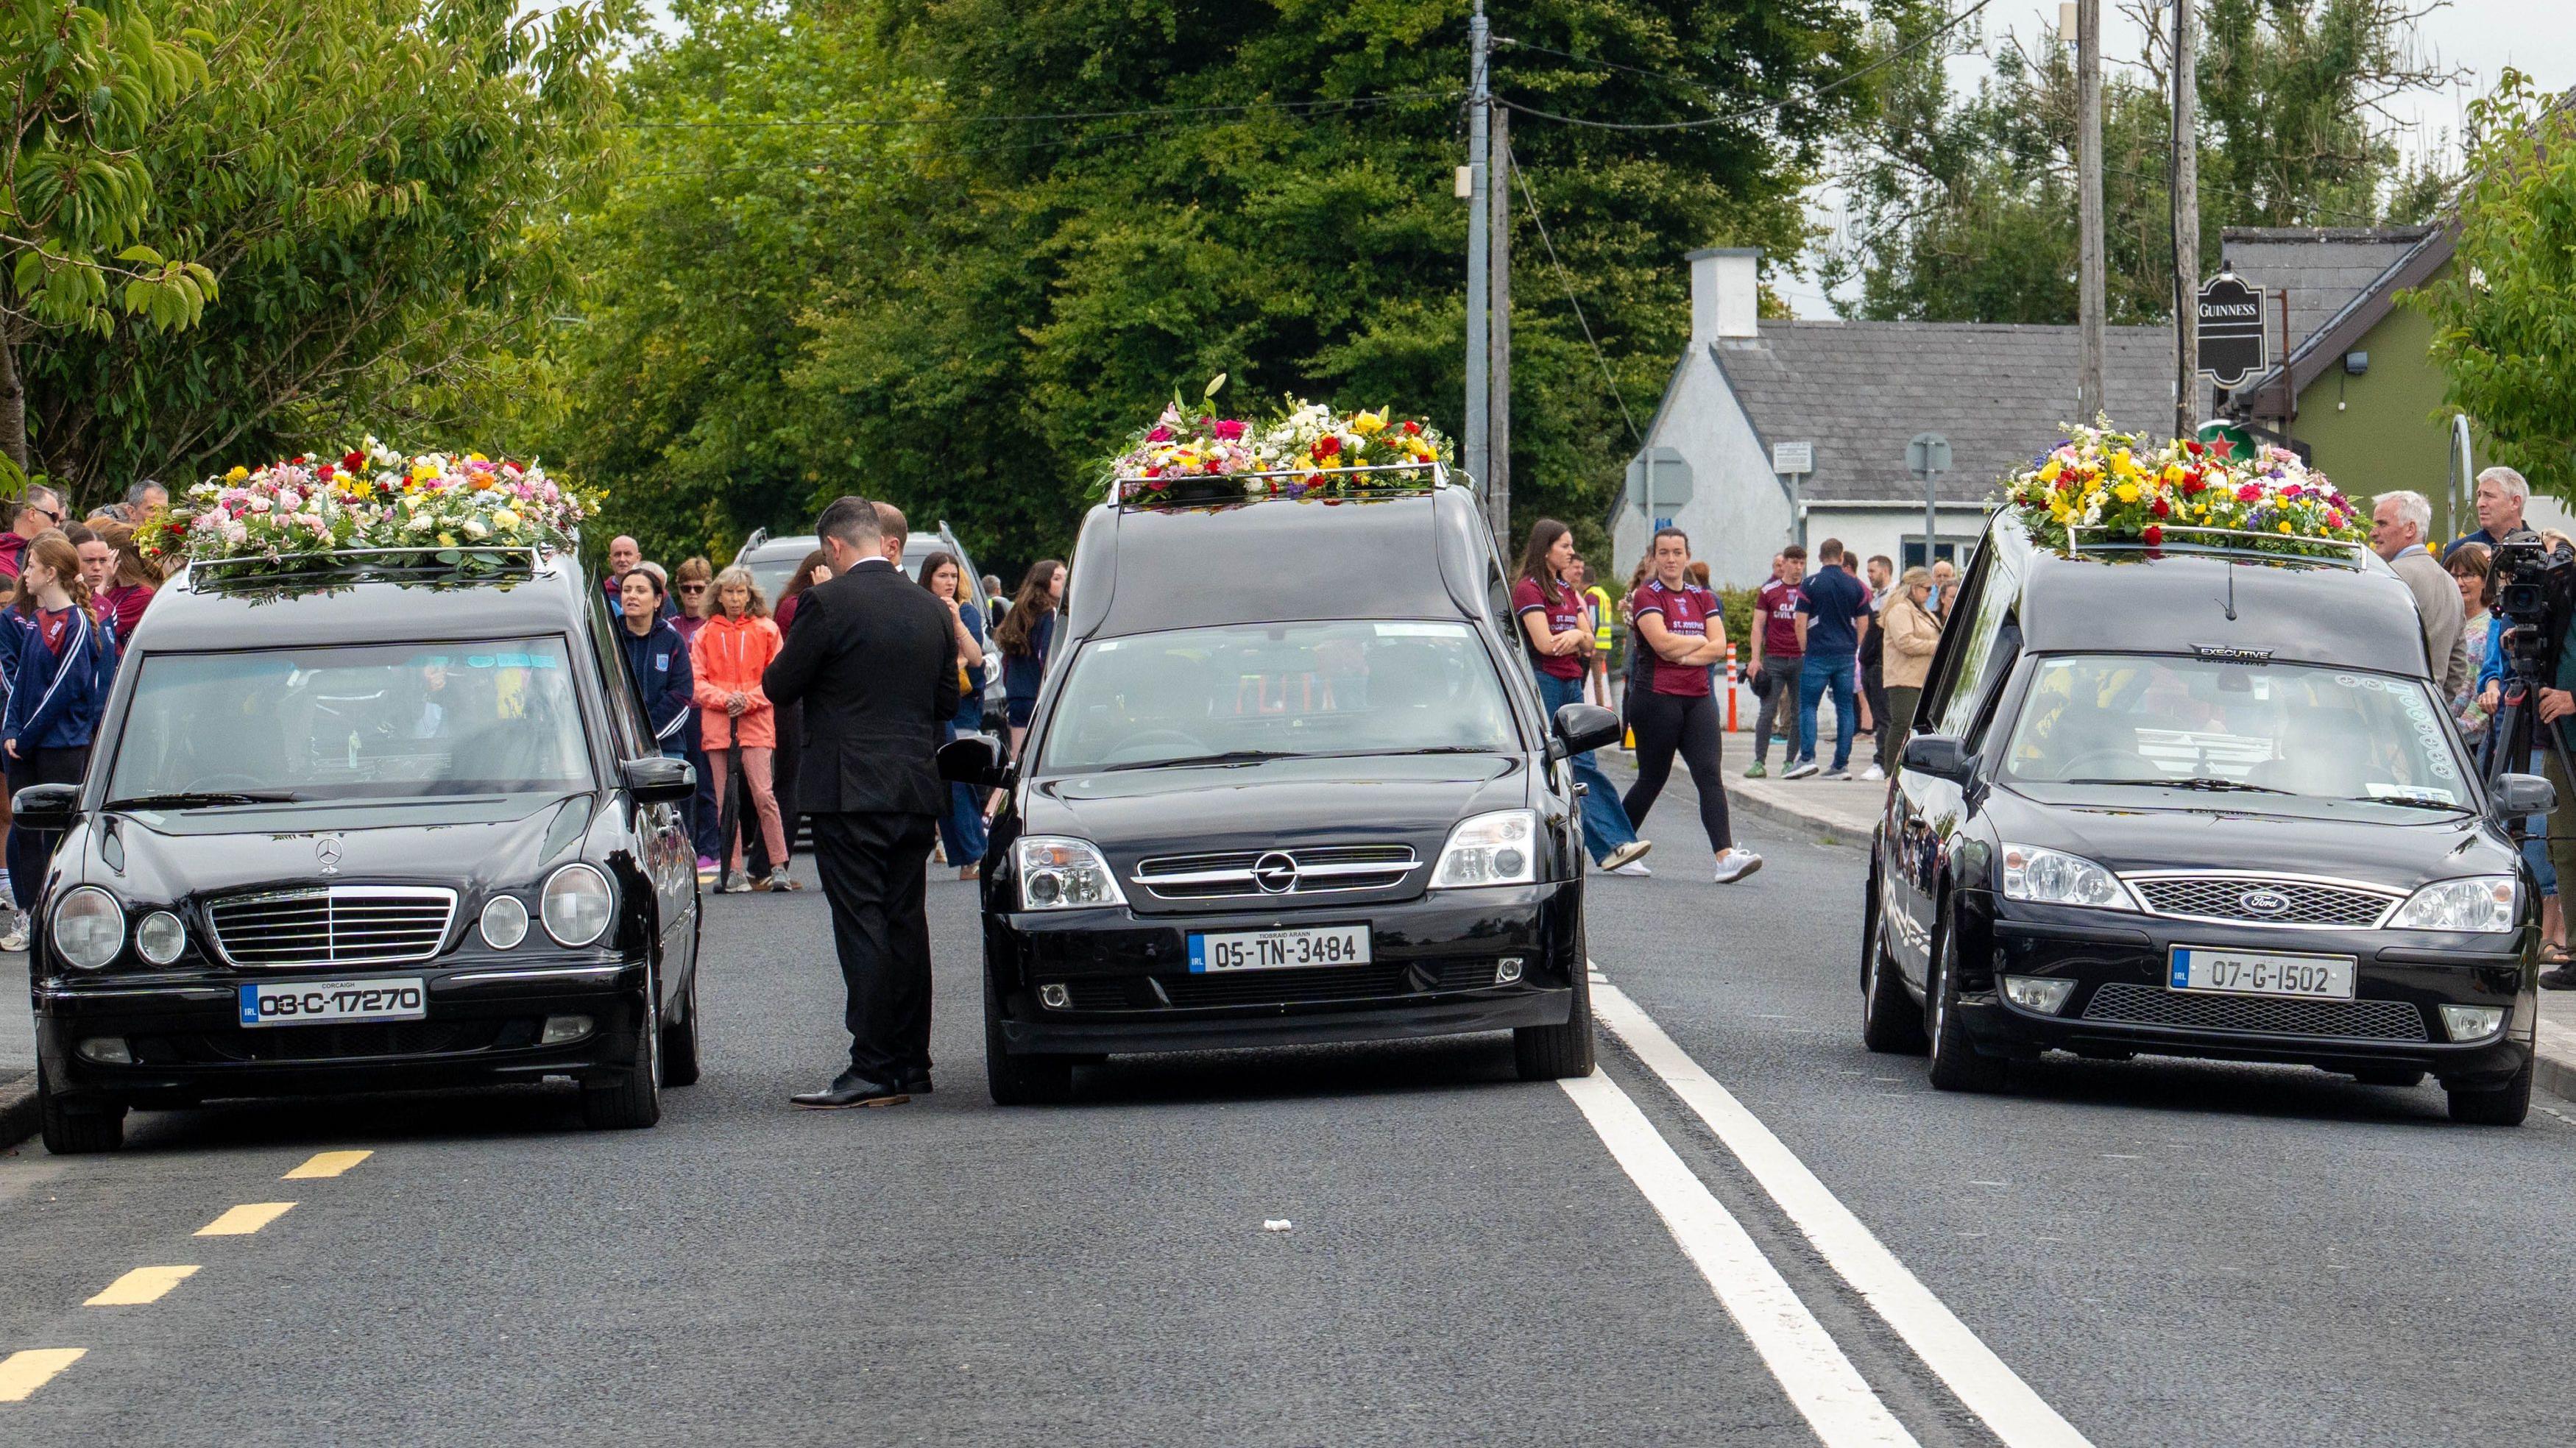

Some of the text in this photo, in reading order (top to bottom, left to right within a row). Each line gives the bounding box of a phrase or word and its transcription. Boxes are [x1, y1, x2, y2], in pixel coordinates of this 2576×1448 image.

[2199, 303, 2257, 317] GUINNESS
[1780, 603, 1794, 611] CLA
[2201, 648, 2268, 659] EXECUTIVE
[2251, 895, 2278, 907] Ford
[1215, 935, 1356, 968] 05-TN-3484
[1192, 957, 1203, 965] IRL
[2174, 972, 2187, 980] IRL
[2212, 961, 2329, 992] 07-G-1502
[259, 987, 420, 1015] 03-C-17270
[244, 1008, 256, 1016] IRL
